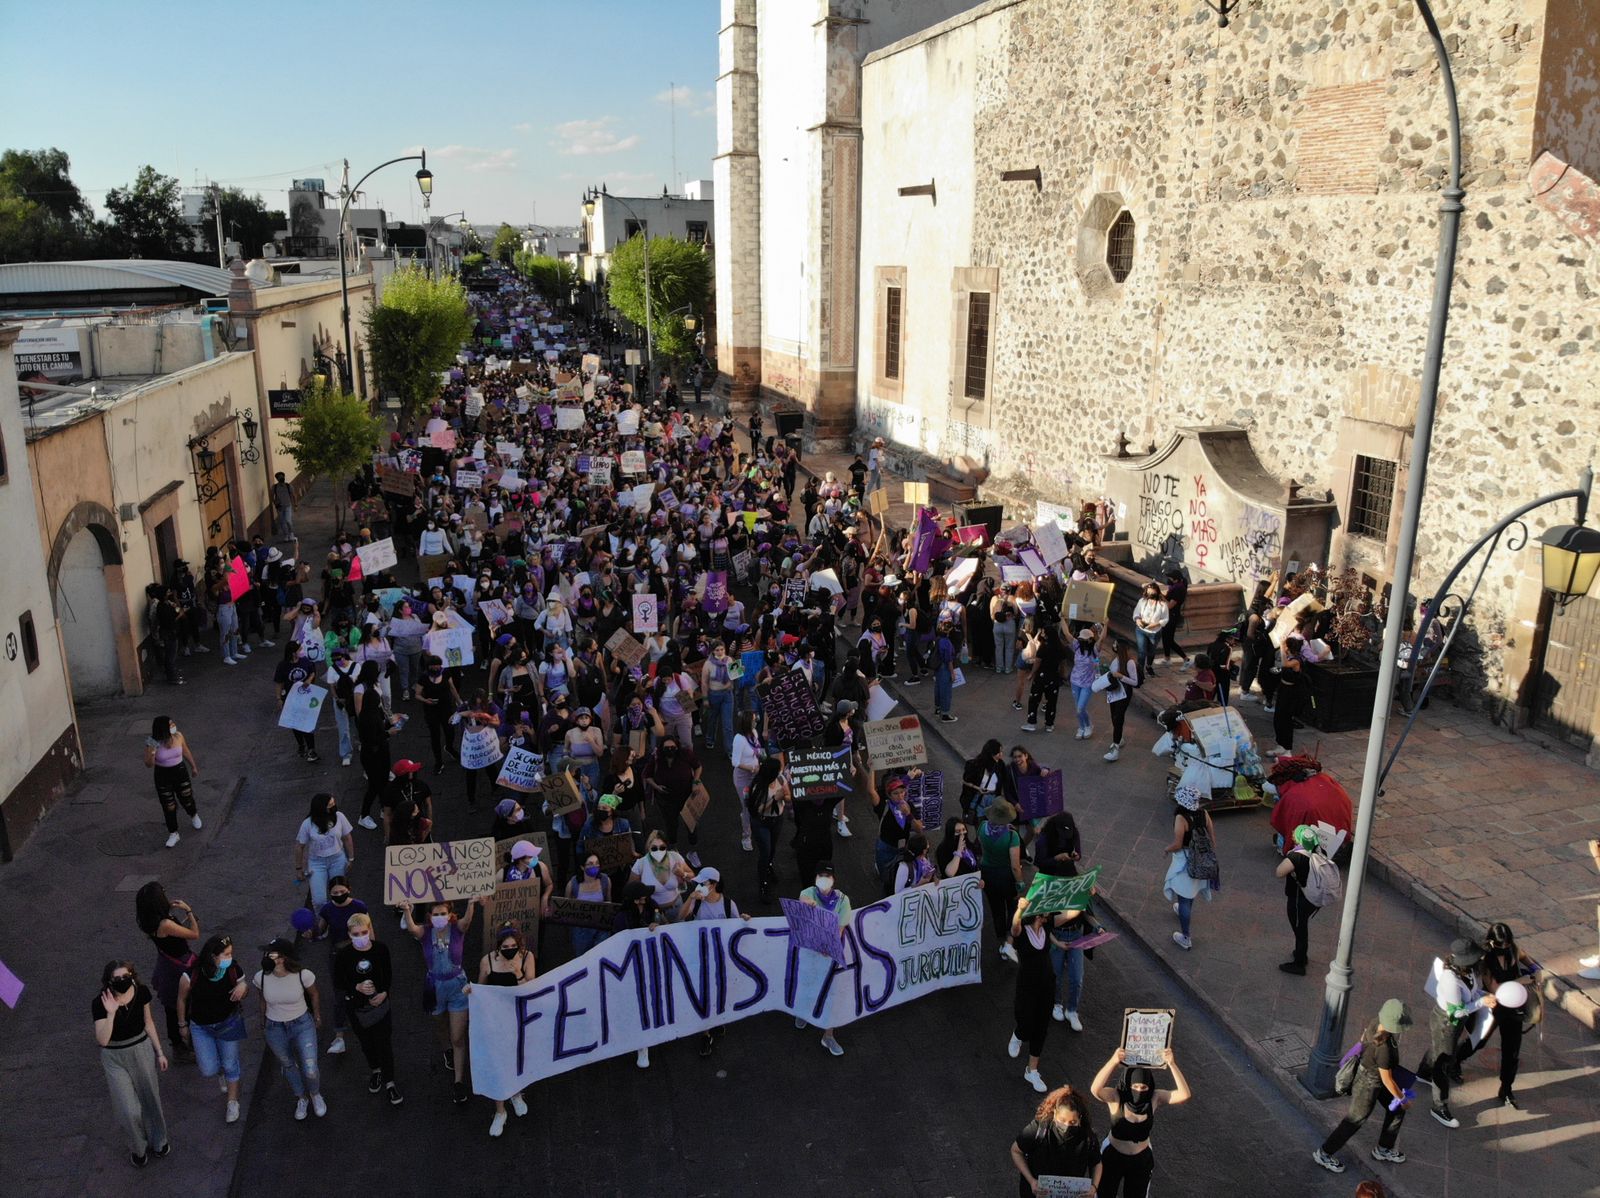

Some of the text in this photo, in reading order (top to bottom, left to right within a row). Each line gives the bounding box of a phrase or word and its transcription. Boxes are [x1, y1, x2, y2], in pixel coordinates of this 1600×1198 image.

[20, 355, 52, 363] BIENESTAR
[53, 354, 61, 362] ES
[61, 353, 70, 361] TU
[50, 362, 74, 370] CAMINO
[1143, 472, 1181, 498] NO TE
[1193, 474, 1207, 498] YA
[1139, 495, 1172, 518] TENGO
[1189, 498, 1207, 518] NO
[1139, 511, 1169, 537] MIEDO
[1191, 518, 1218, 544] MAS
[1218, 534, 1249, 560] VIVAN
[513, 751, 523, 761] SE
[806, 751, 832, 760] MÉXICO
[913, 743, 924, 755] NO
[508, 760, 519, 769] DE
[841, 762, 848, 770] A
[790, 771, 844, 786] UN QUE A
[793, 787, 805, 798] UN
[389, 846, 426, 867] L@S
[432, 838, 493, 861] NÑ@S
[455, 860, 491, 871] TOCAN
[456, 869, 493, 881] MATAN
[388, 867, 429, 901] NO
[456, 881, 495, 895] VIOLAN
[1031, 870, 1098, 900] ABORTO
[898, 876, 982, 949] ENES
[1021, 897, 1081, 917] LEGAL
[514, 900, 897, 1077] FEMINISTAS
